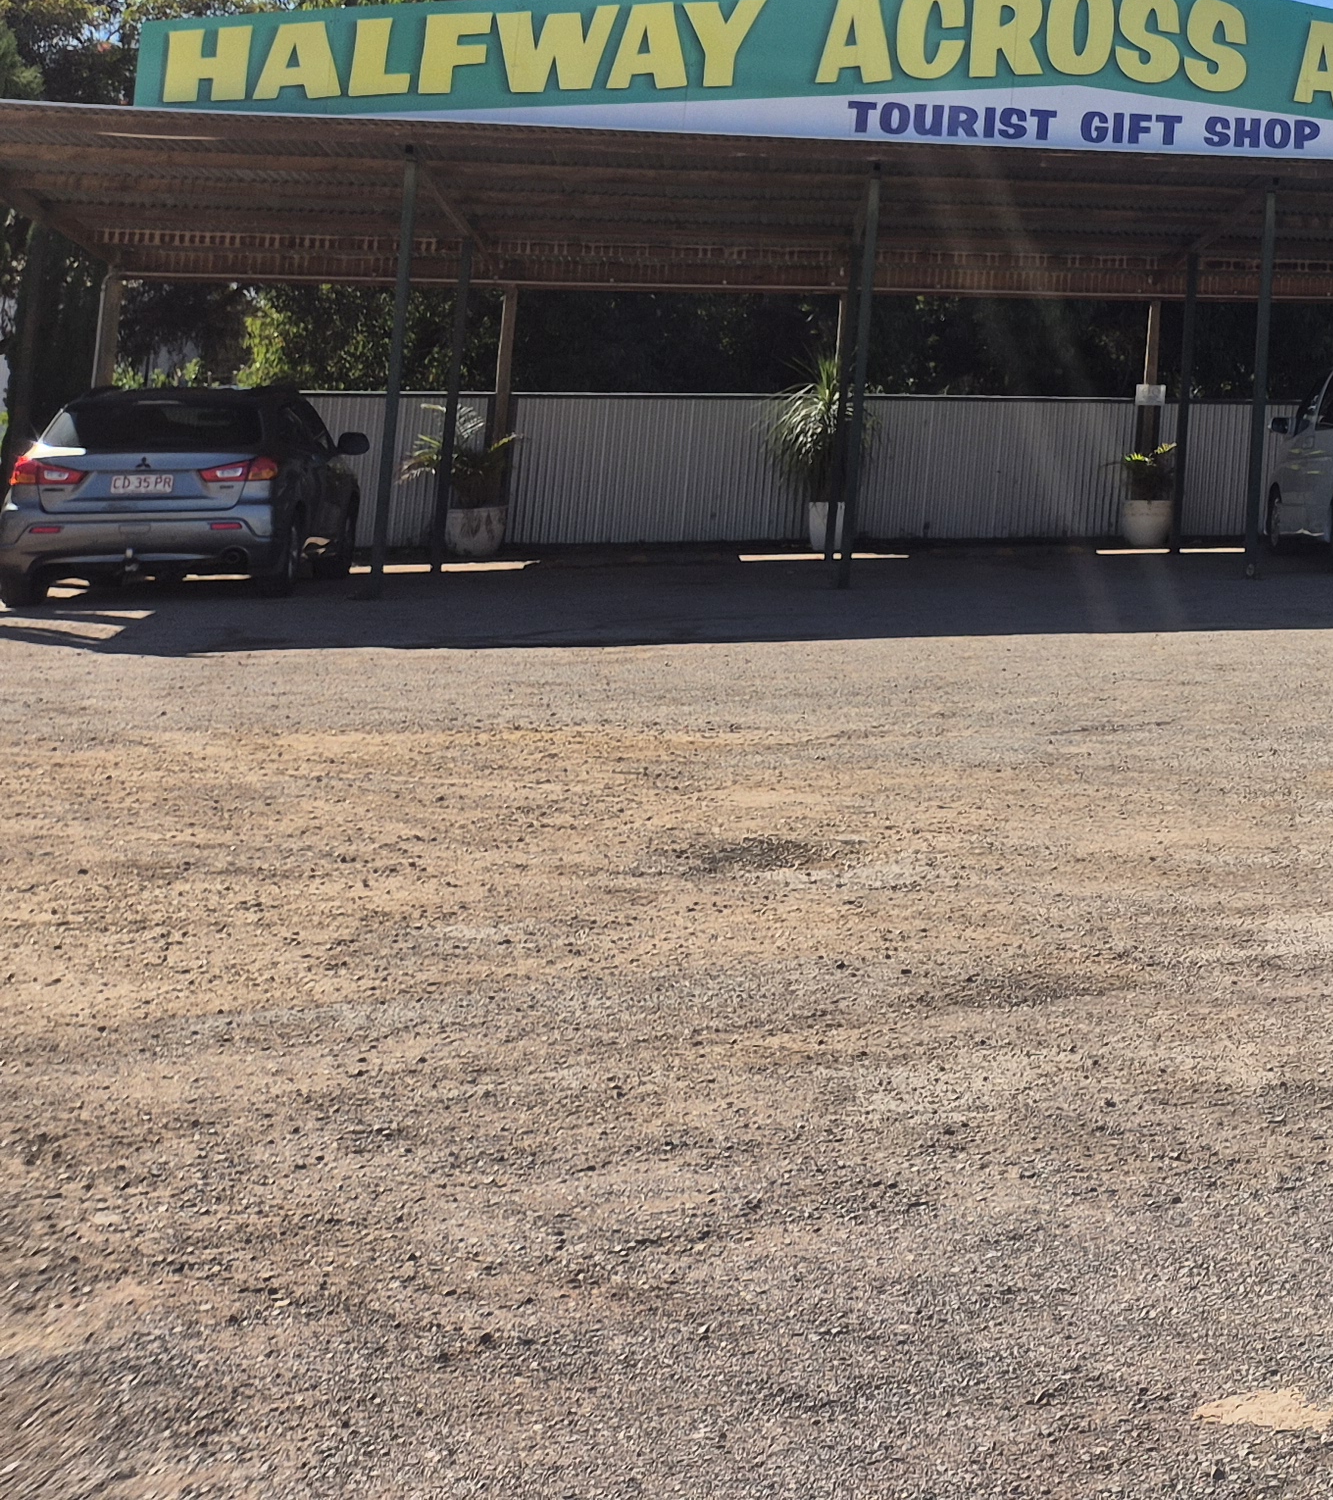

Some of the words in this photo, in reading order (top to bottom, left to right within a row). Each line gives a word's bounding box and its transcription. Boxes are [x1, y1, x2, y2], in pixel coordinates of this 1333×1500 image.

[848, 100, 1058, 140] TOURIST
[1080, 111, 1183, 146] GIFT
[1203, 116, 1321, 150] SHOP
[113, 476, 131, 489] CD
[135, 476, 151, 489] 35
[154, 475, 172, 489] PR
